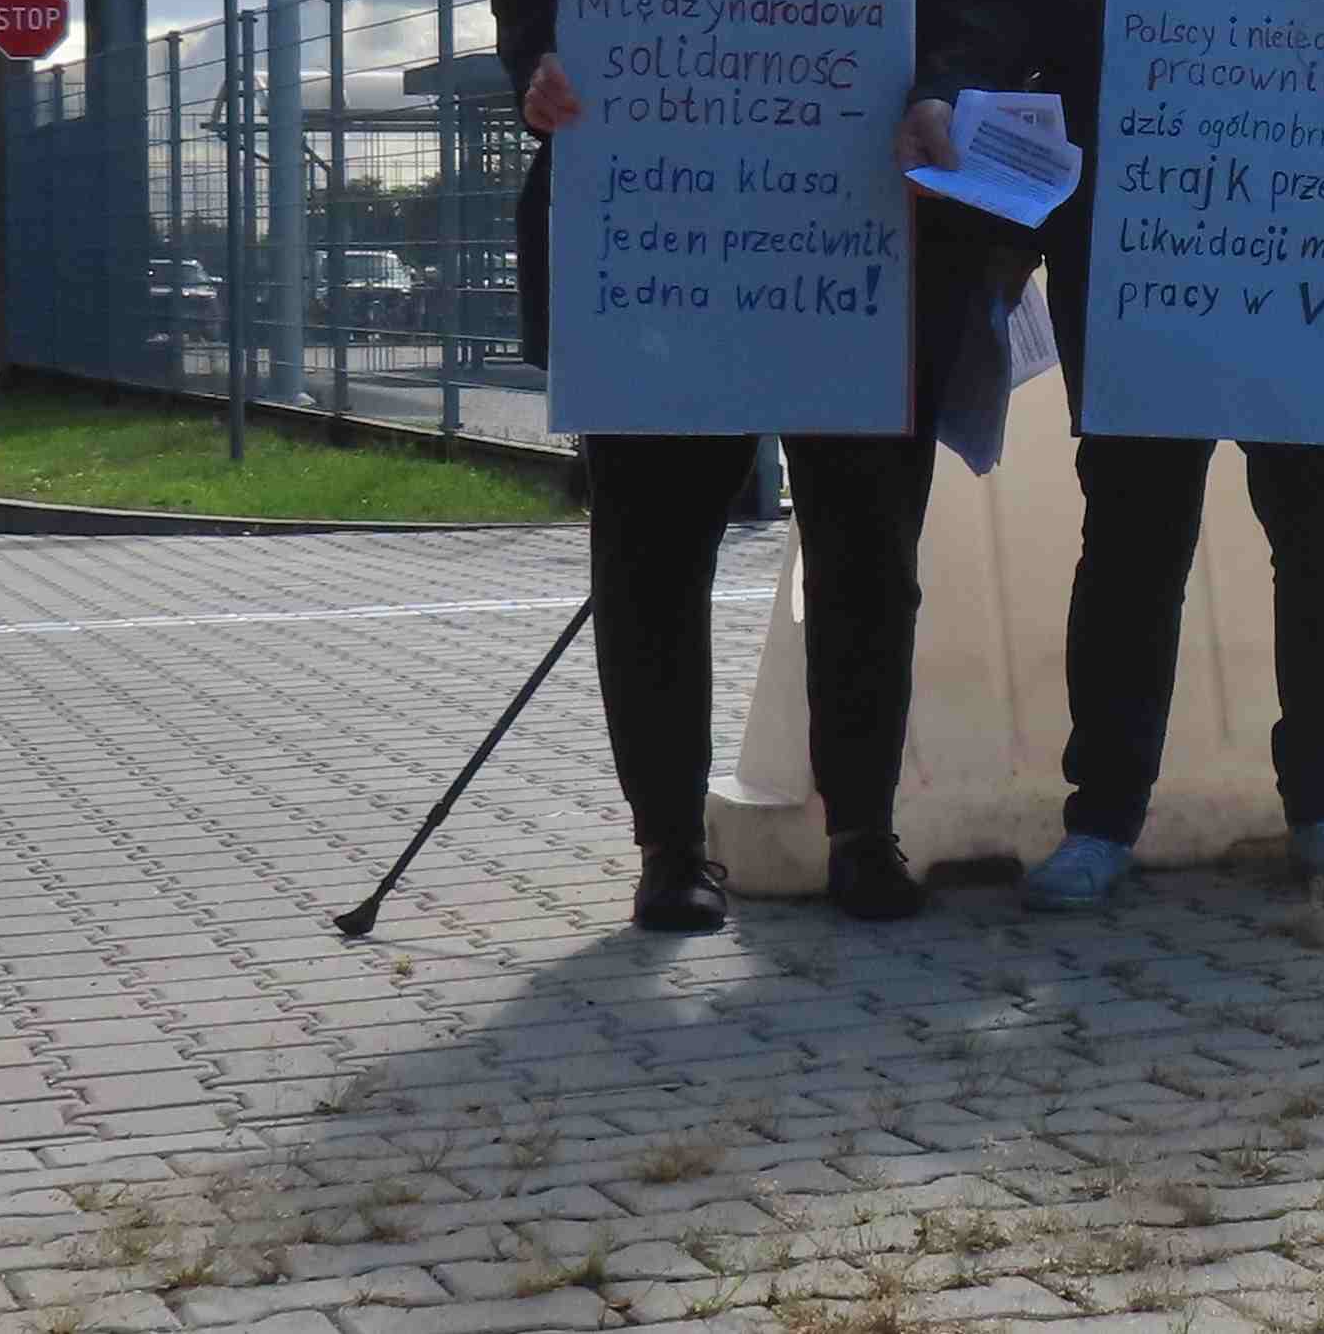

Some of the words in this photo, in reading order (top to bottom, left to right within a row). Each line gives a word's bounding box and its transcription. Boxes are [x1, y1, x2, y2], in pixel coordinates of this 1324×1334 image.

[1126, 12, 1215, 55] Polscy
[1229, 16, 1238, 48] i
[603, 34, 859, 89] solidarność
[605, 86, 821, 126] robtnicza
[1120, 102, 1185, 137] dziś
[600, 155, 715, 203] jedna
[599, 215, 707, 260] jeden
[597, 271, 710, 315] jedna
[1117, 281, 1220, 320] pracy
[1243, 289, 1274, 315] w
